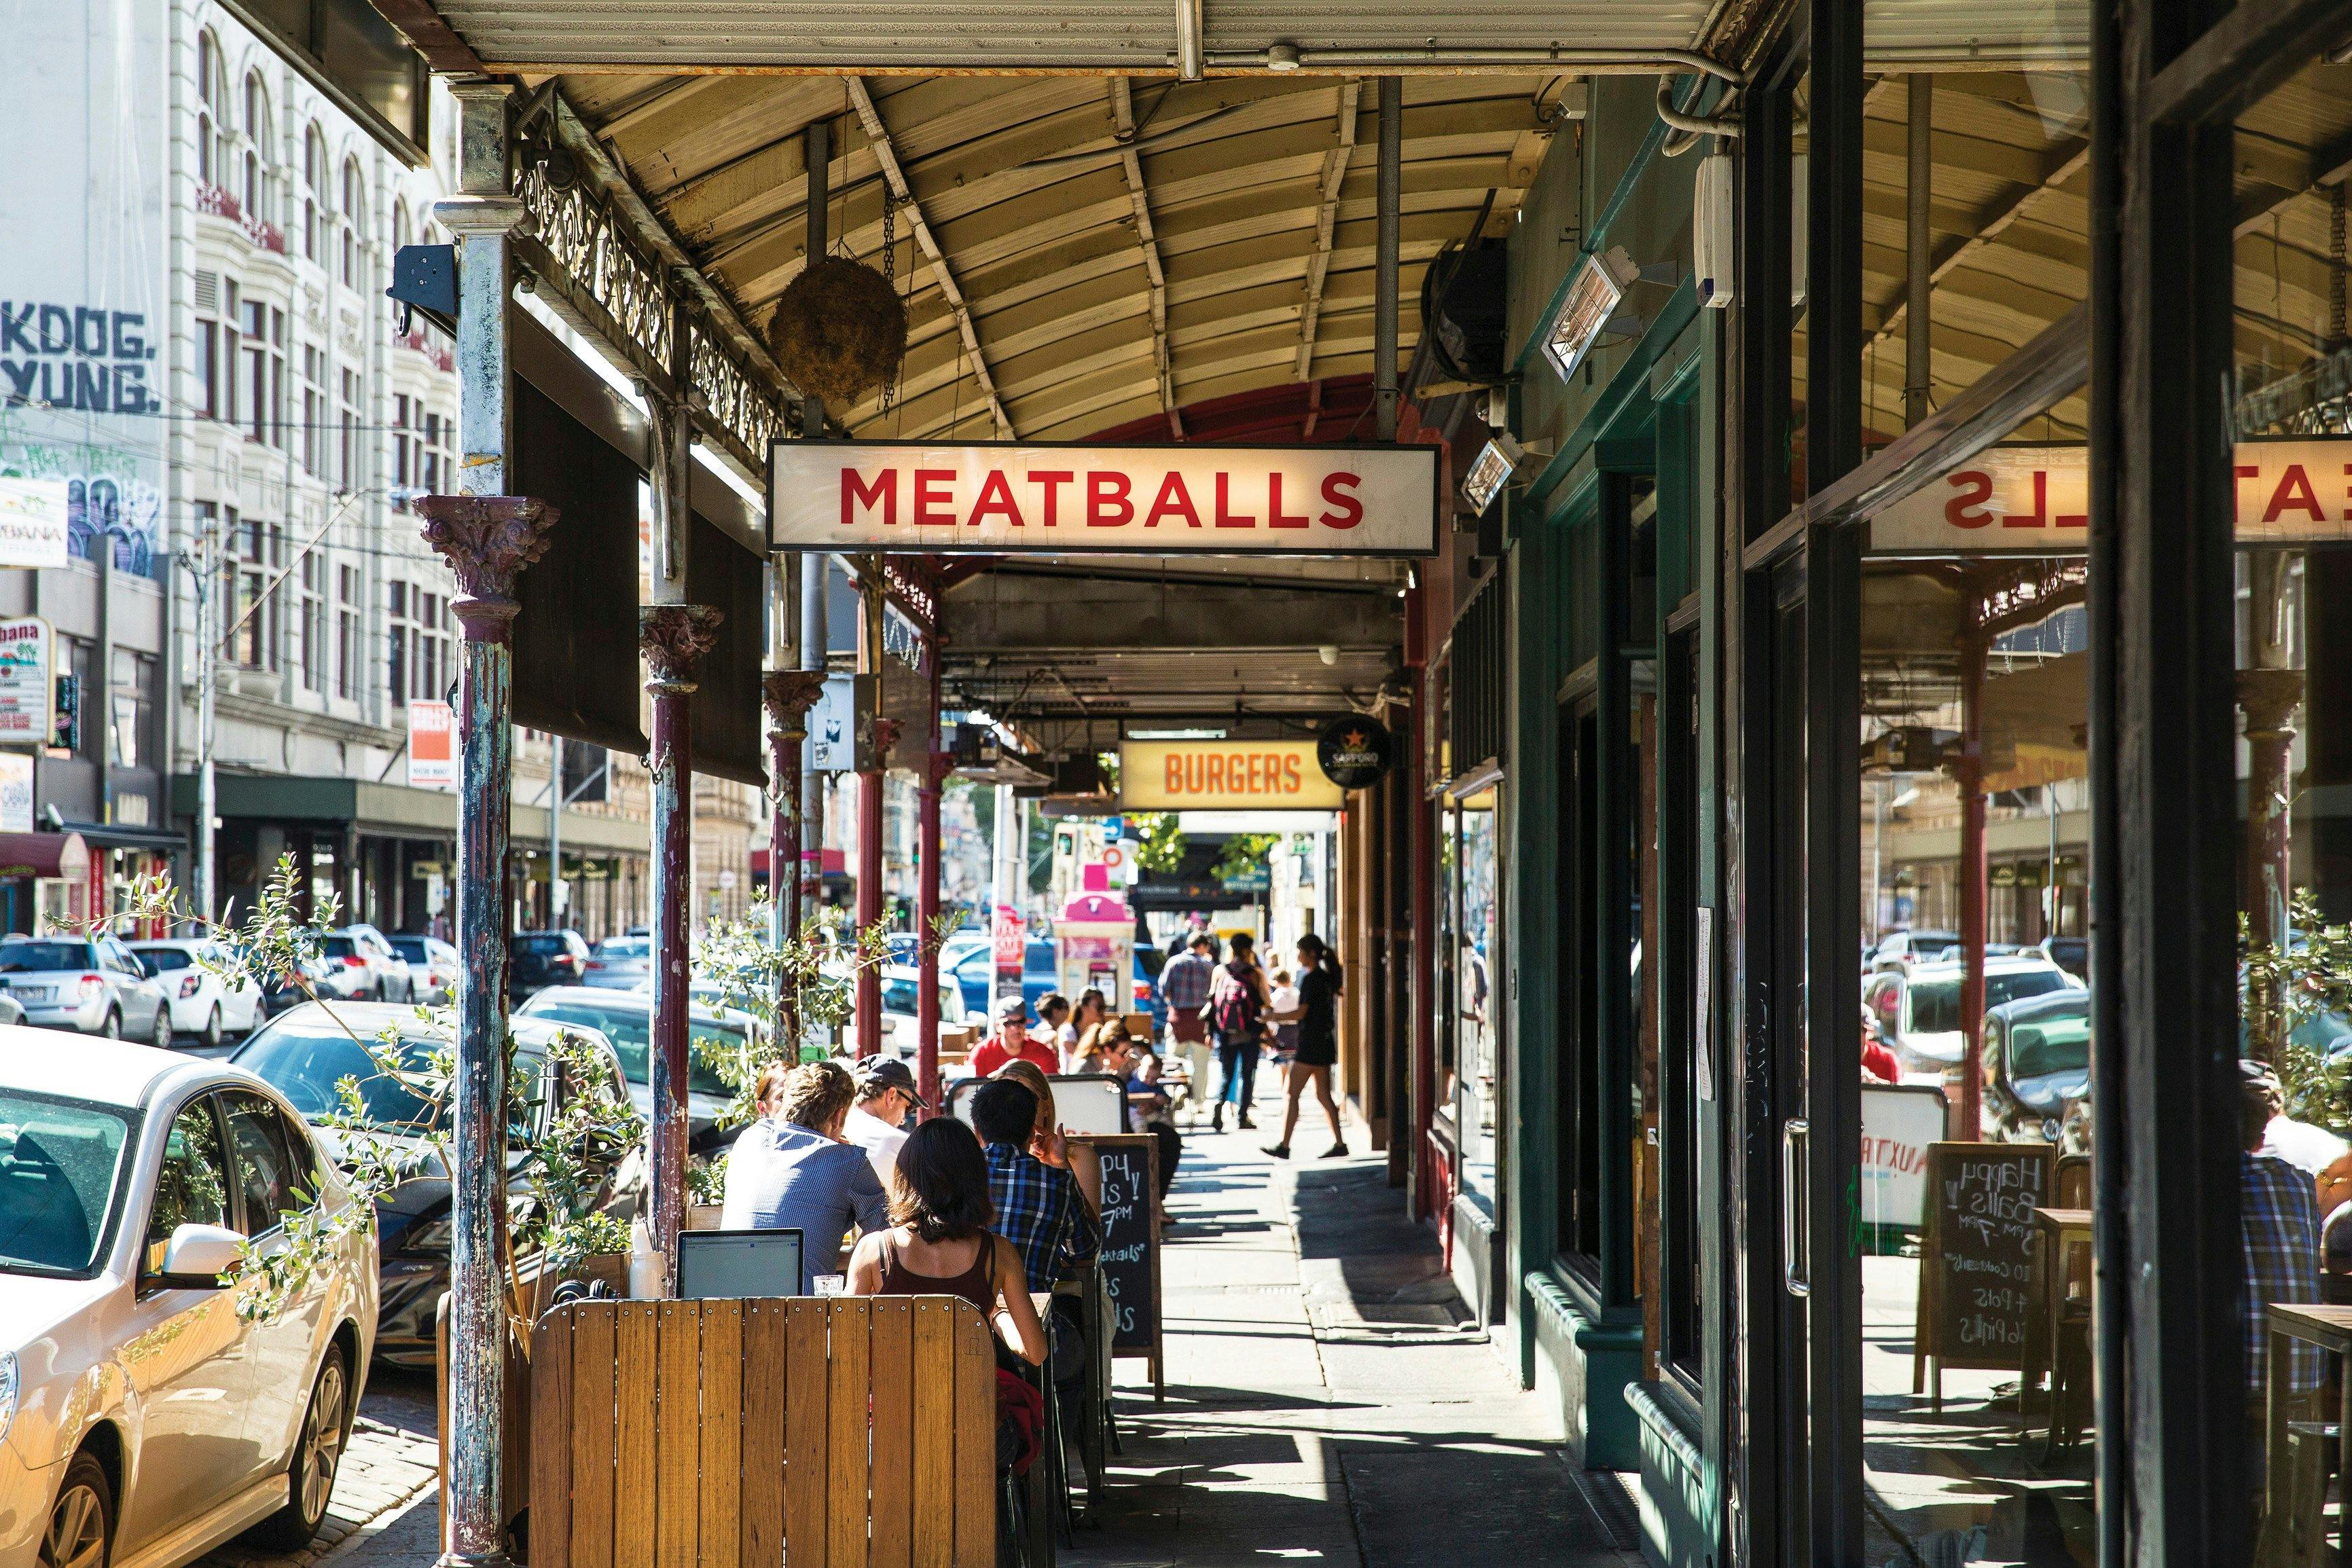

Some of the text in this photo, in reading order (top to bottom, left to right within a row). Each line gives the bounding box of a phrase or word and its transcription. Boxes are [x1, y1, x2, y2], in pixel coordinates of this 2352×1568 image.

[0, 359, 160, 415] YUNG.
[841, 468, 1362, 530] MEATBALLS
[1165, 753, 1301, 795] BURGERS
[1331, 752, 1379, 765] SAPPORO
